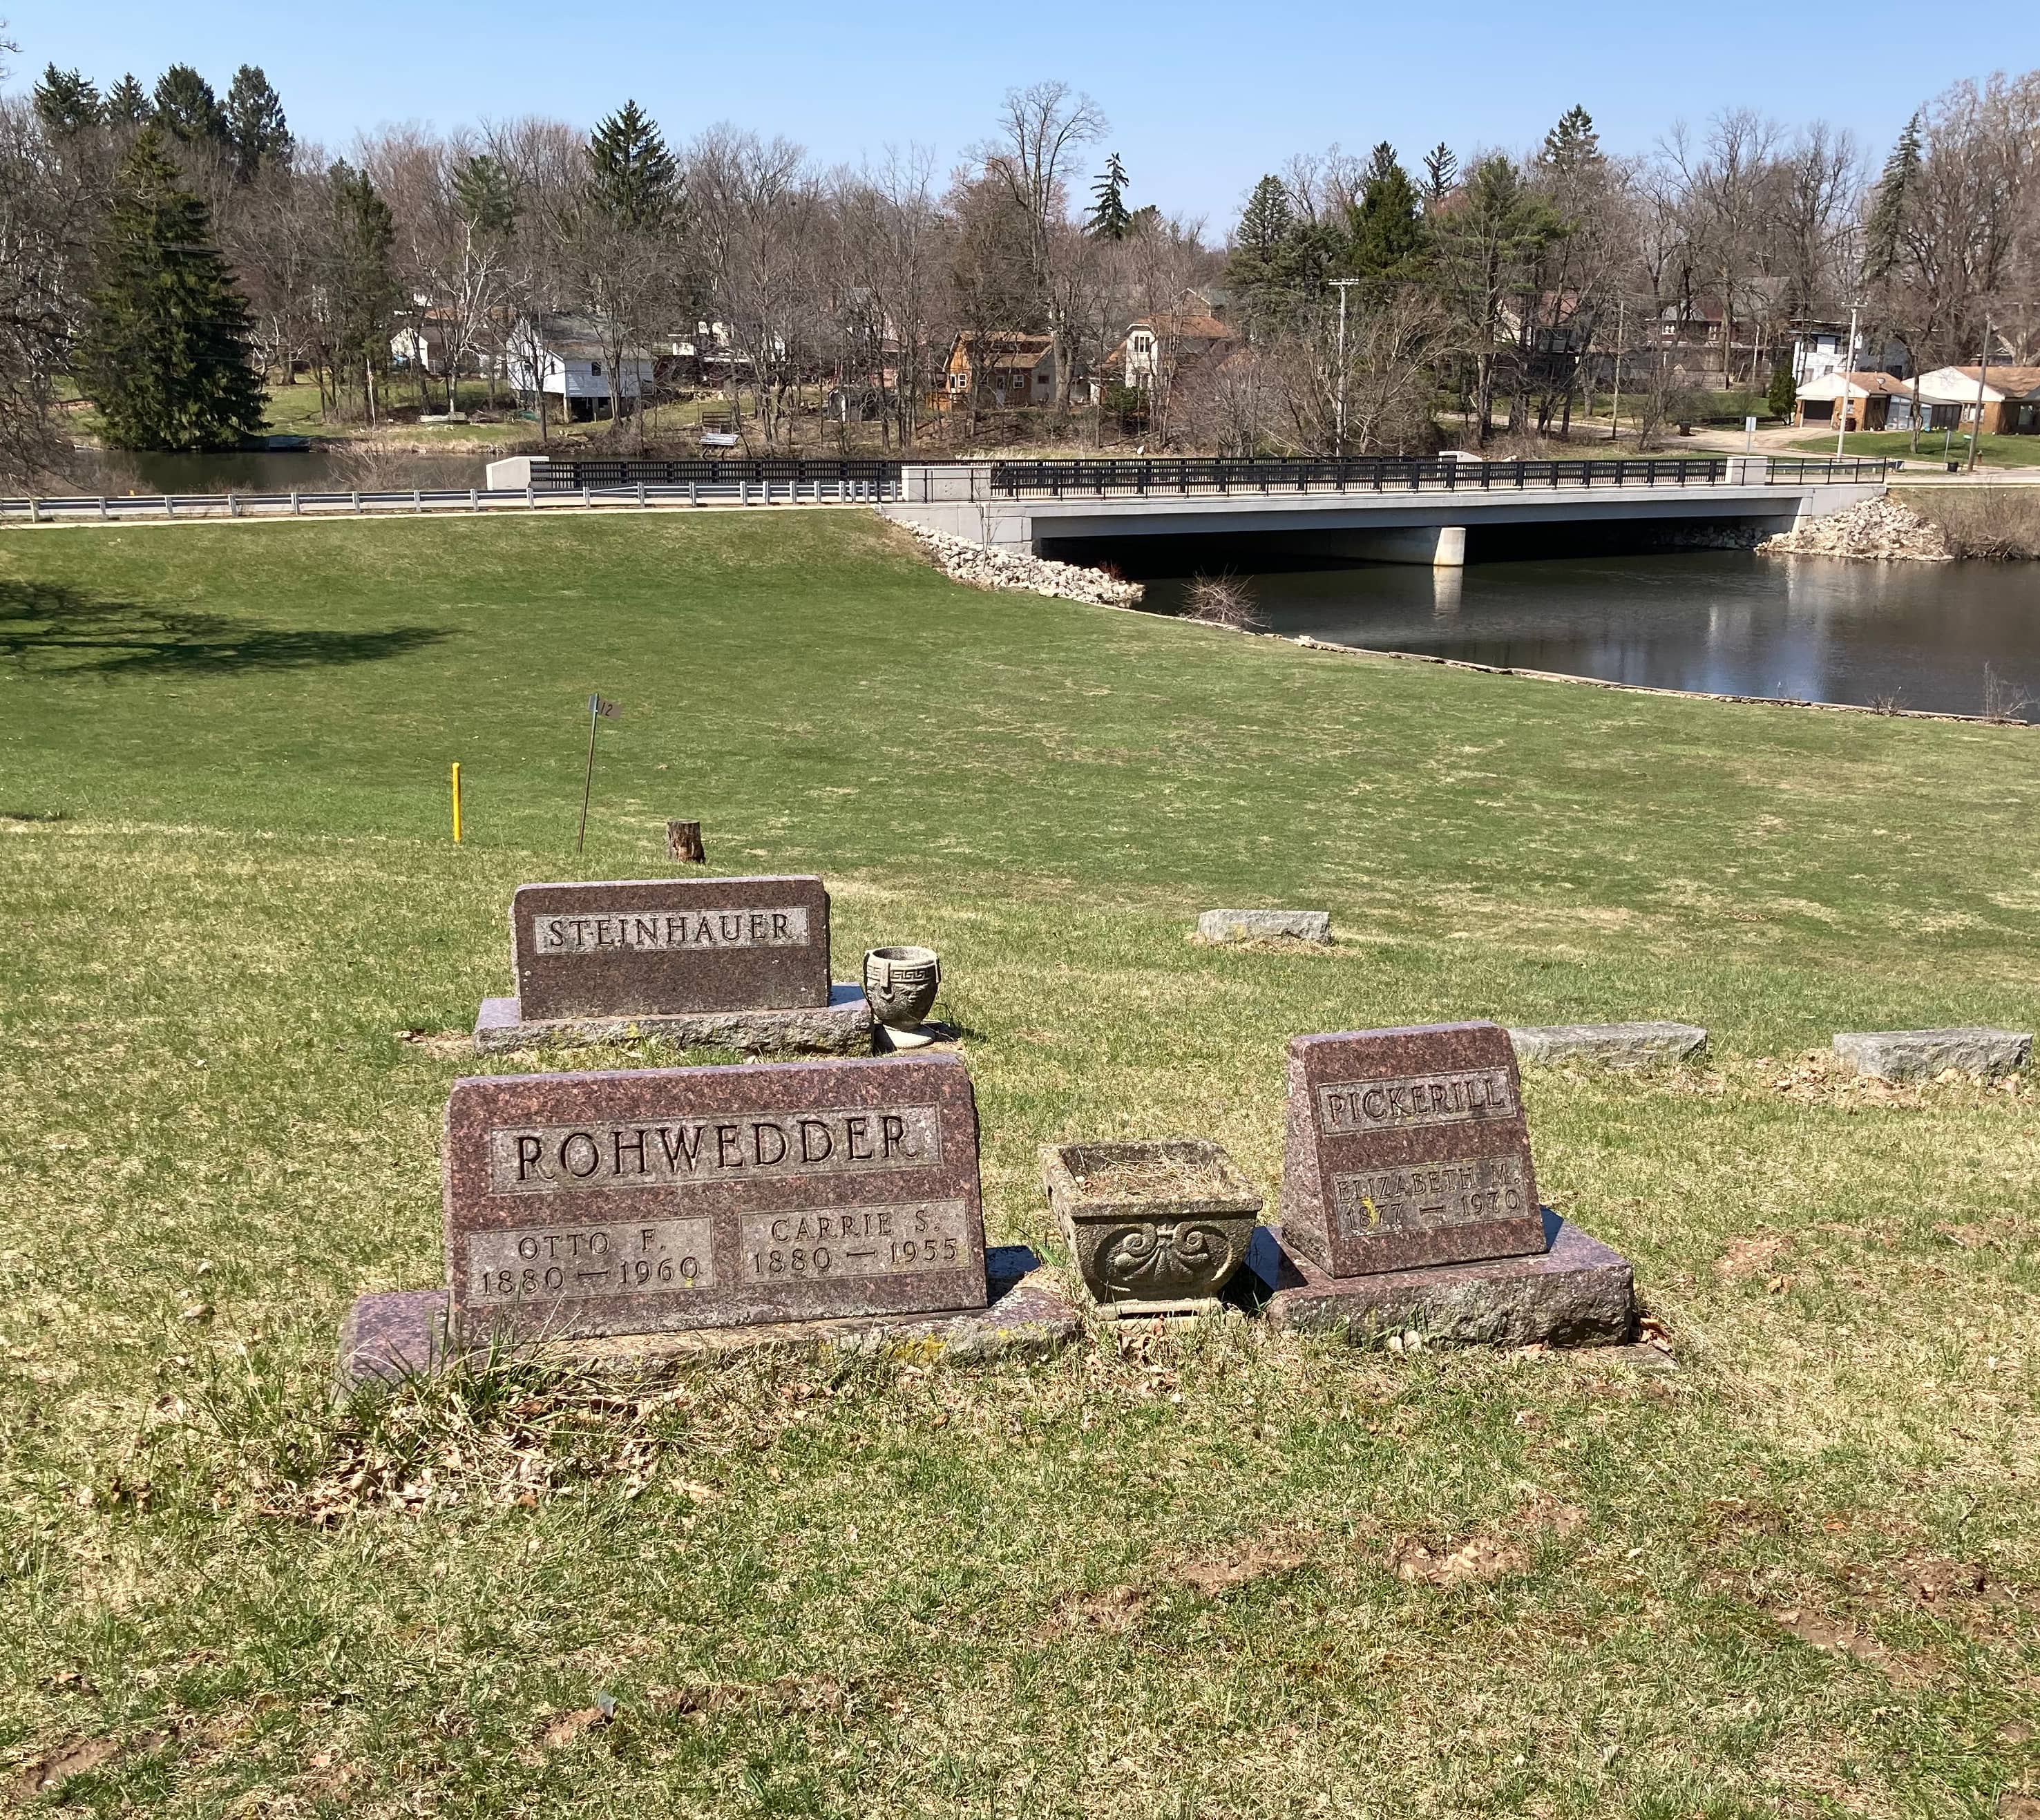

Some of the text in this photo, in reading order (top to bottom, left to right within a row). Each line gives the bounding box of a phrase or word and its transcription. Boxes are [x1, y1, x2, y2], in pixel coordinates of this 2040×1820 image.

[600, 702, 613, 717] 12
[550, 913, 790, 947] STEINHAUER
[1328, 1080, 1505, 1123] PICKERILL
[515, 1115, 919, 1182] ROHWEDDER
[1337, 1162, 1520, 1202] ELIZABETH M.
[772, 1209, 941, 1243] CARRIE S.
[1346, 1203, 1404, 1231] 1877
[1460, 1189, 1520, 1217] 1970
[518, 1229, 667, 1261] OTTO F.
[754, 1247, 832, 1274] 1880
[889, 1238, 959, 1265] 1955
[482, 1266, 564, 1296] 1880
[620, 1256, 700, 1286] 1960
